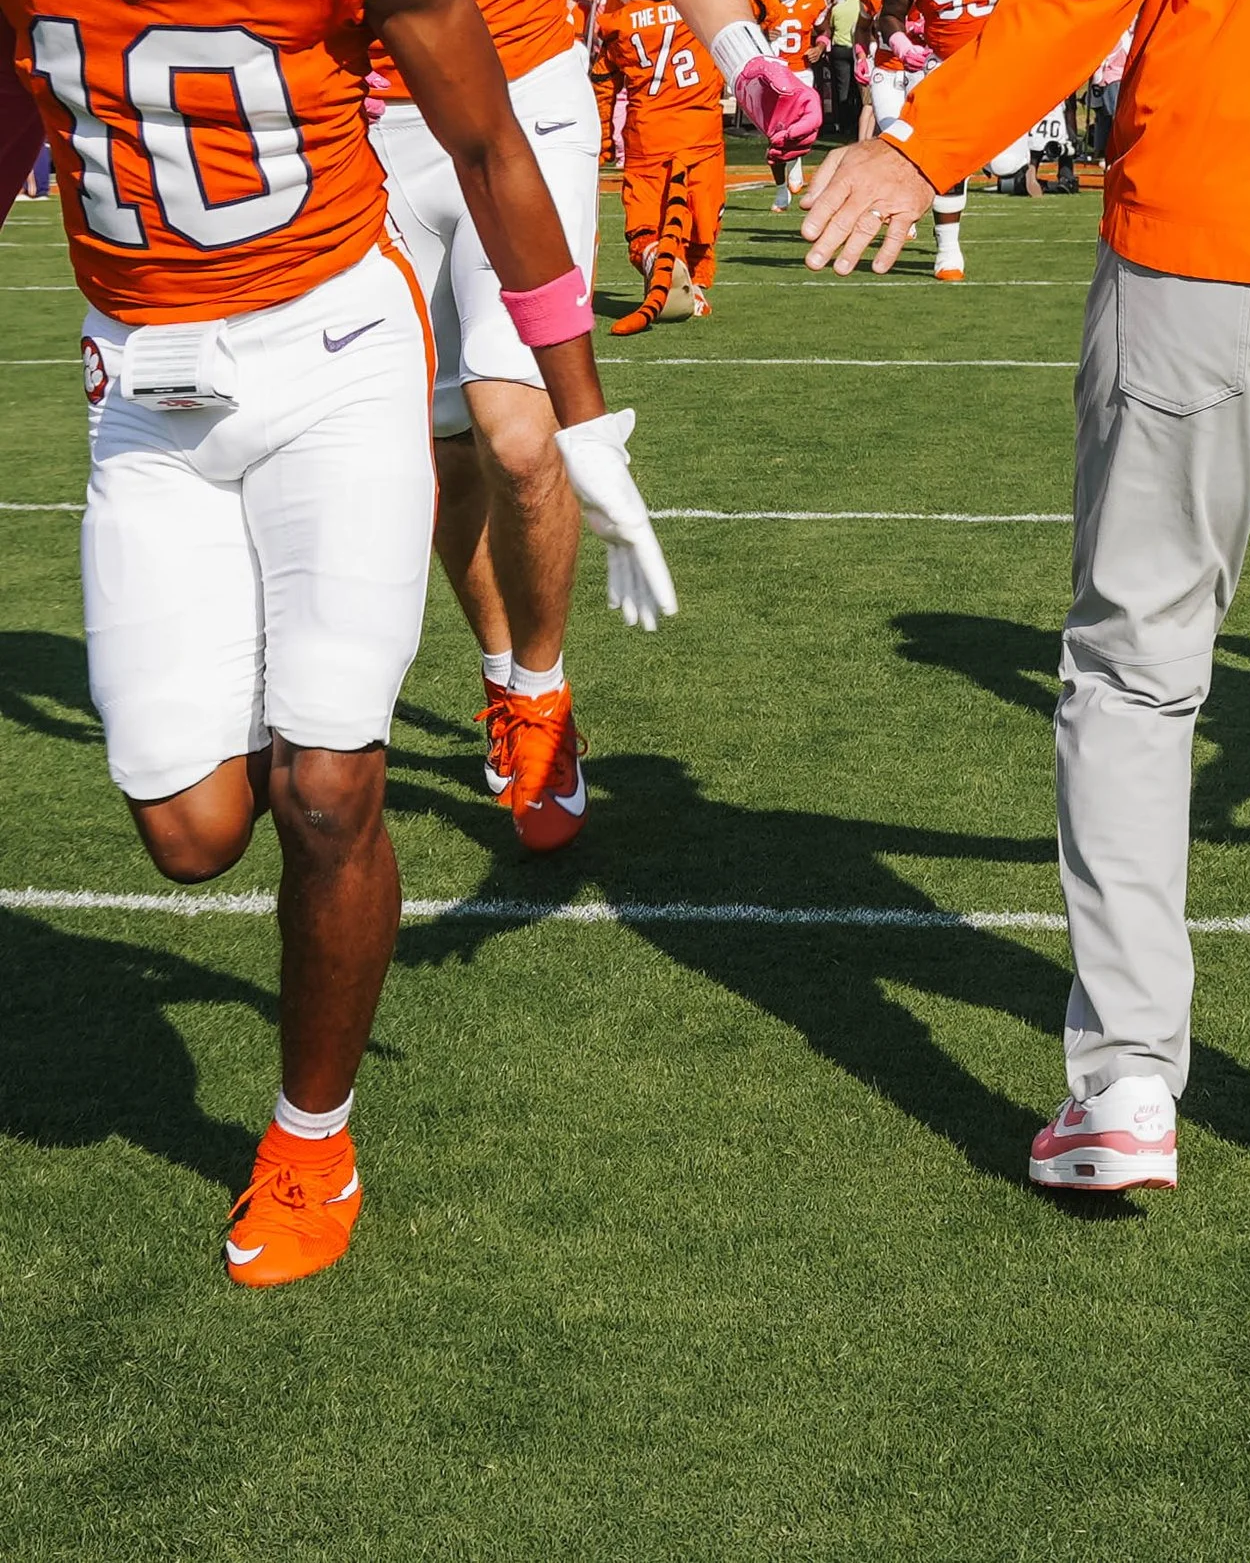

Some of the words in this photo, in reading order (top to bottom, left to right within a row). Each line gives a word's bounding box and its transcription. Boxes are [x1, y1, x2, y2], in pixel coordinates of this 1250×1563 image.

[630, 7, 656, 29] THE
[779, 19, 802, 54] 6
[29, 15, 313, 251] 10
[1138, 1105, 1161, 1114] NIKE
